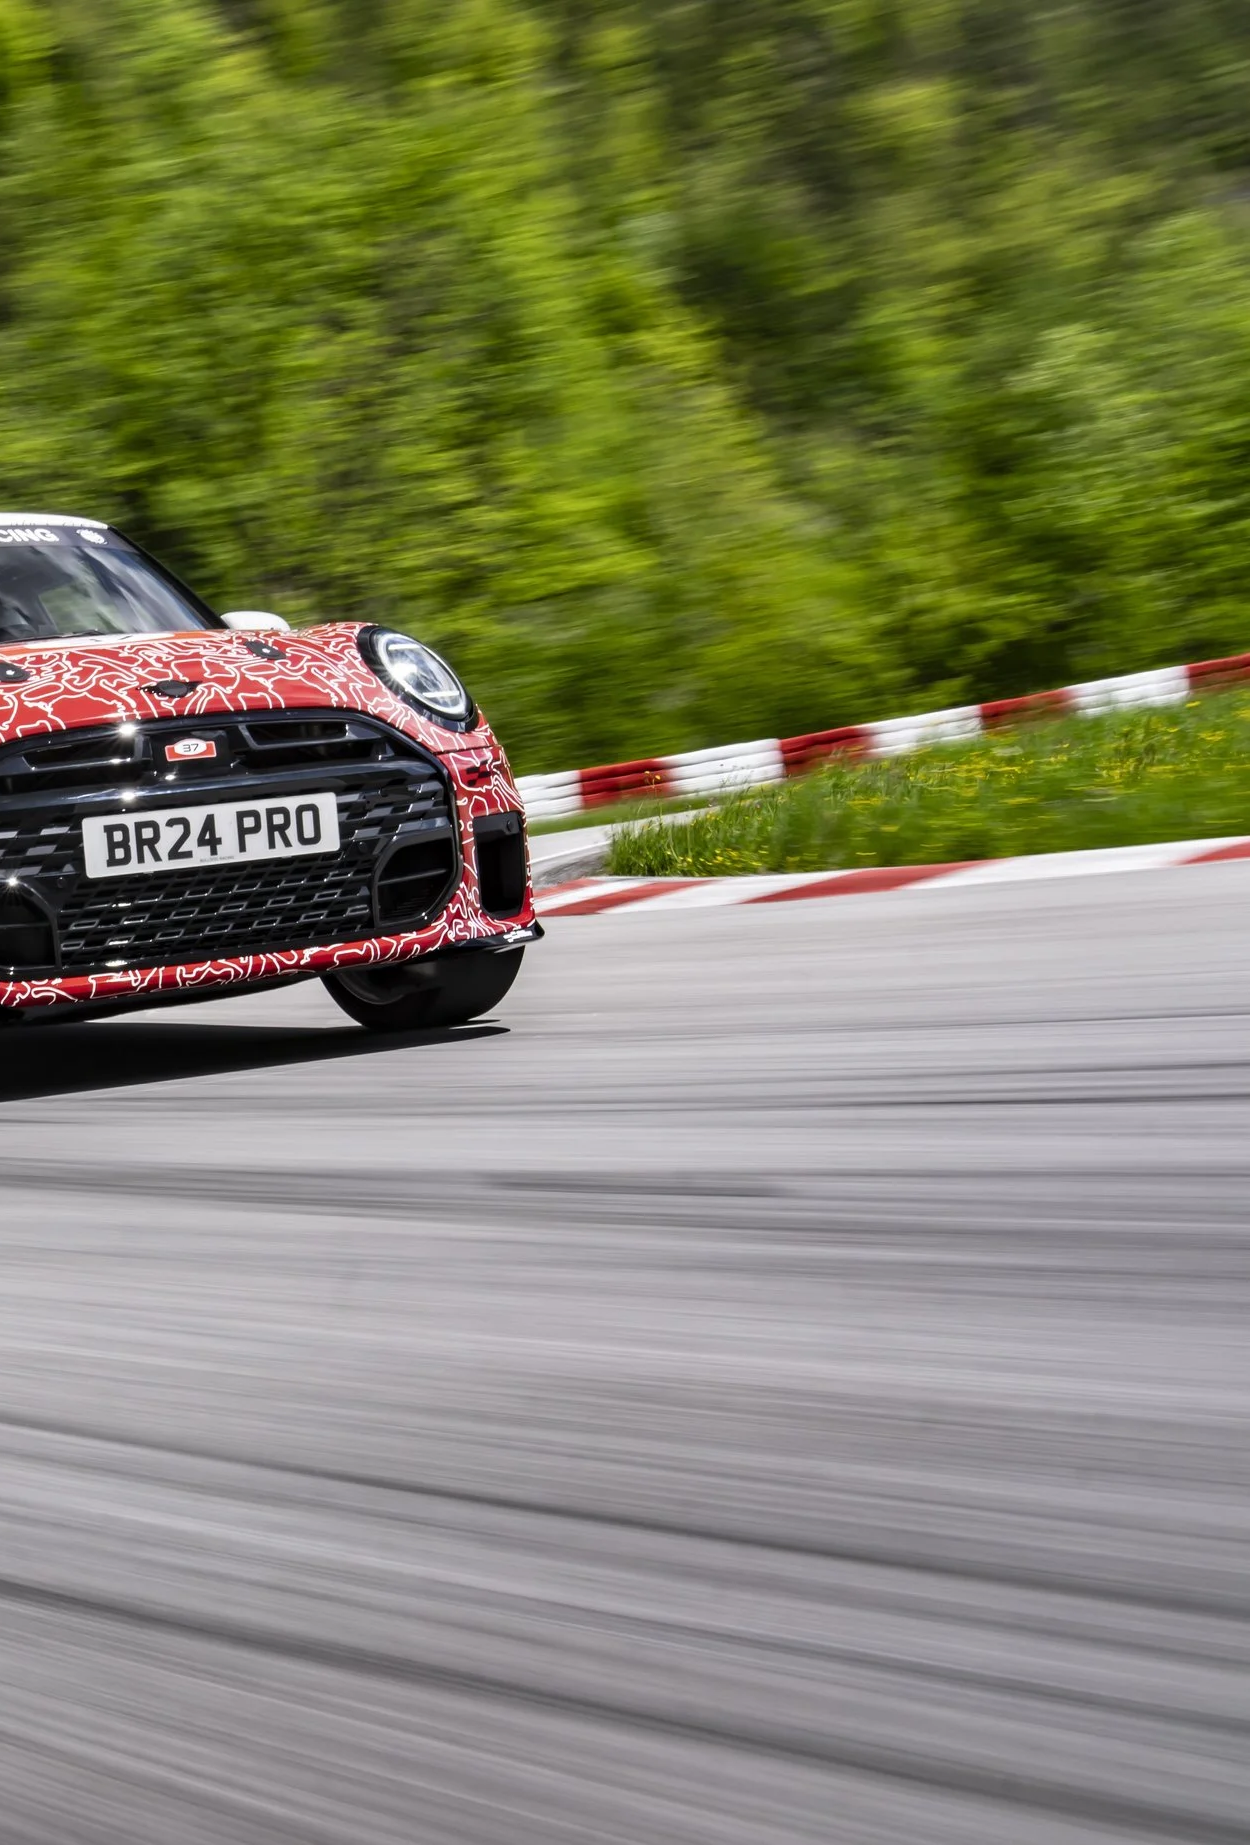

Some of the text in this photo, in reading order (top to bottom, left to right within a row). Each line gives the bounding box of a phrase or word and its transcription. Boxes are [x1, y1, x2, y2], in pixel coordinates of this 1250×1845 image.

[182, 743, 199, 753] 37
[103, 803, 322, 867] BR24 PRO
